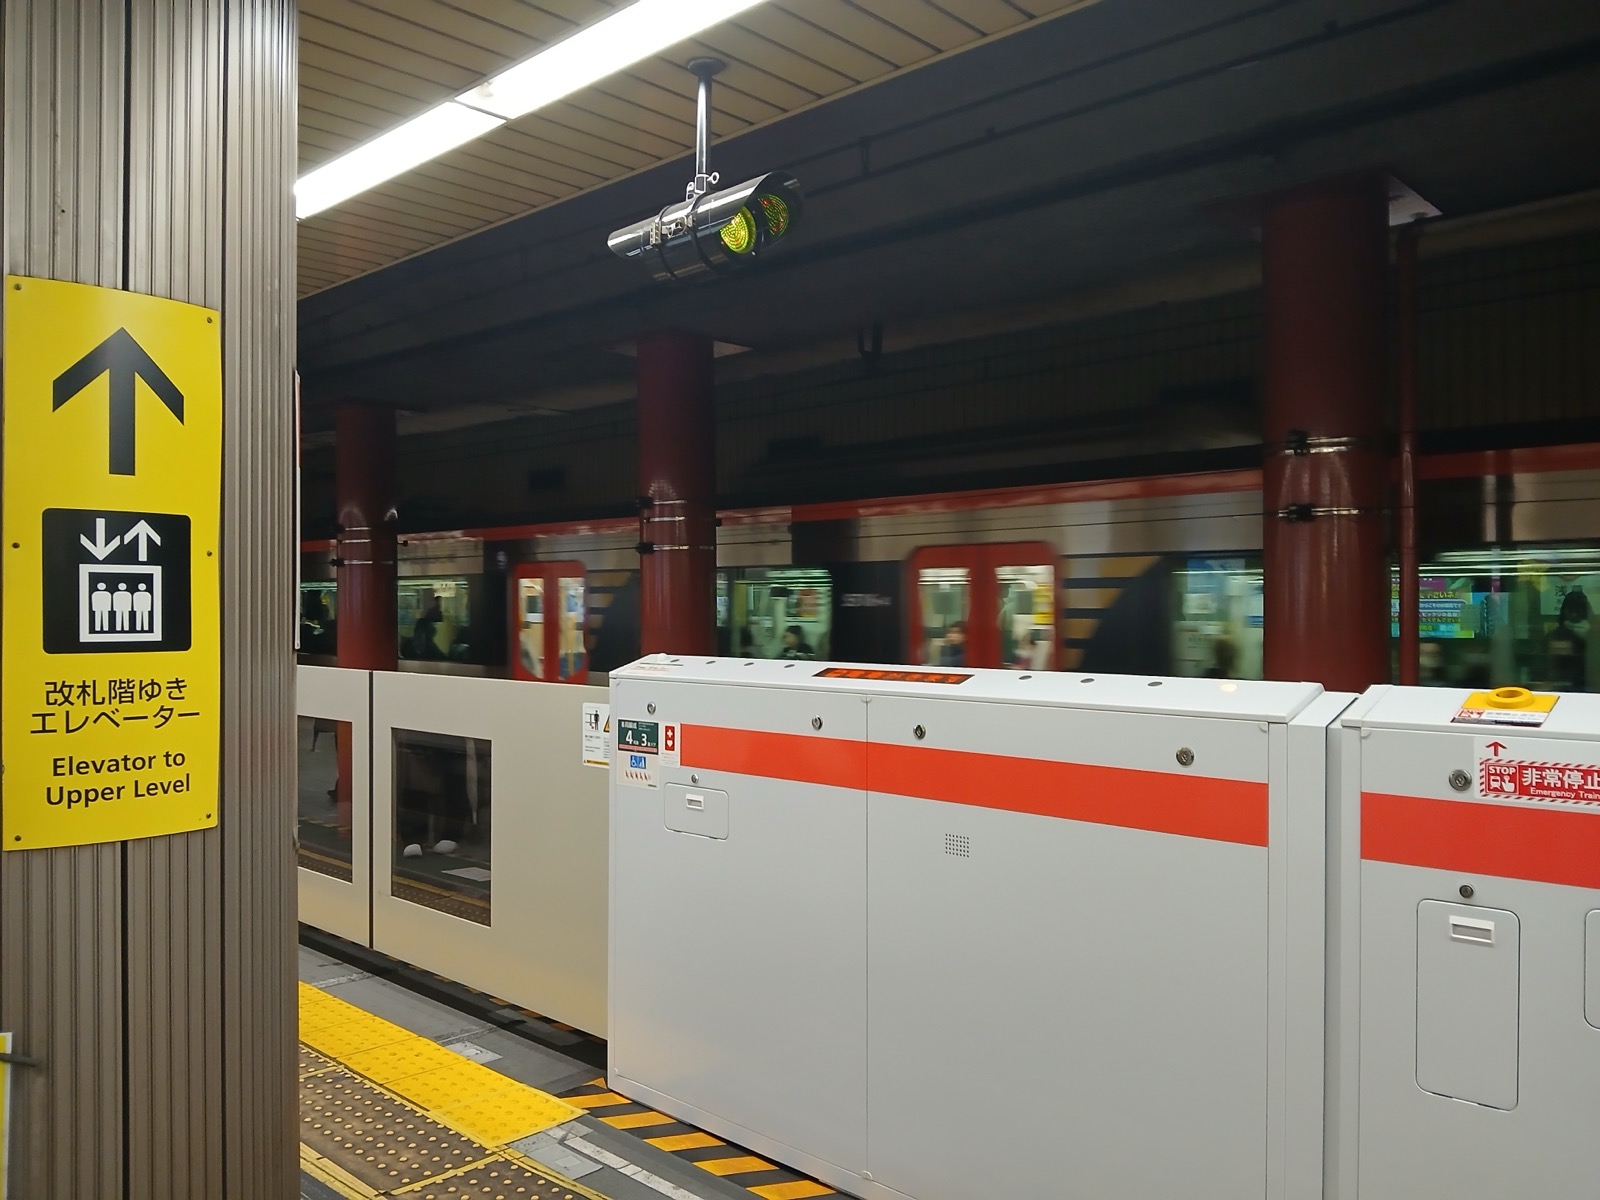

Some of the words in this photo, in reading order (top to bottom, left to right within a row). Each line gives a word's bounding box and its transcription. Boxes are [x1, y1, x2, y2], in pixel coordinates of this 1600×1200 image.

[45, 678, 188, 706] 改札階ゆき
[30, 705, 200, 734] エレベーター
[52, 755, 156, 776] Elevator
[163, 751, 186, 767] to
[1489, 766, 1516, 775] STOP
[46, 783, 125, 809] Upper
[134, 773, 190, 798] Level
[1522, 768, 1600, 789] 非常停止
[1530, 787, 1576, 798] Emergency
